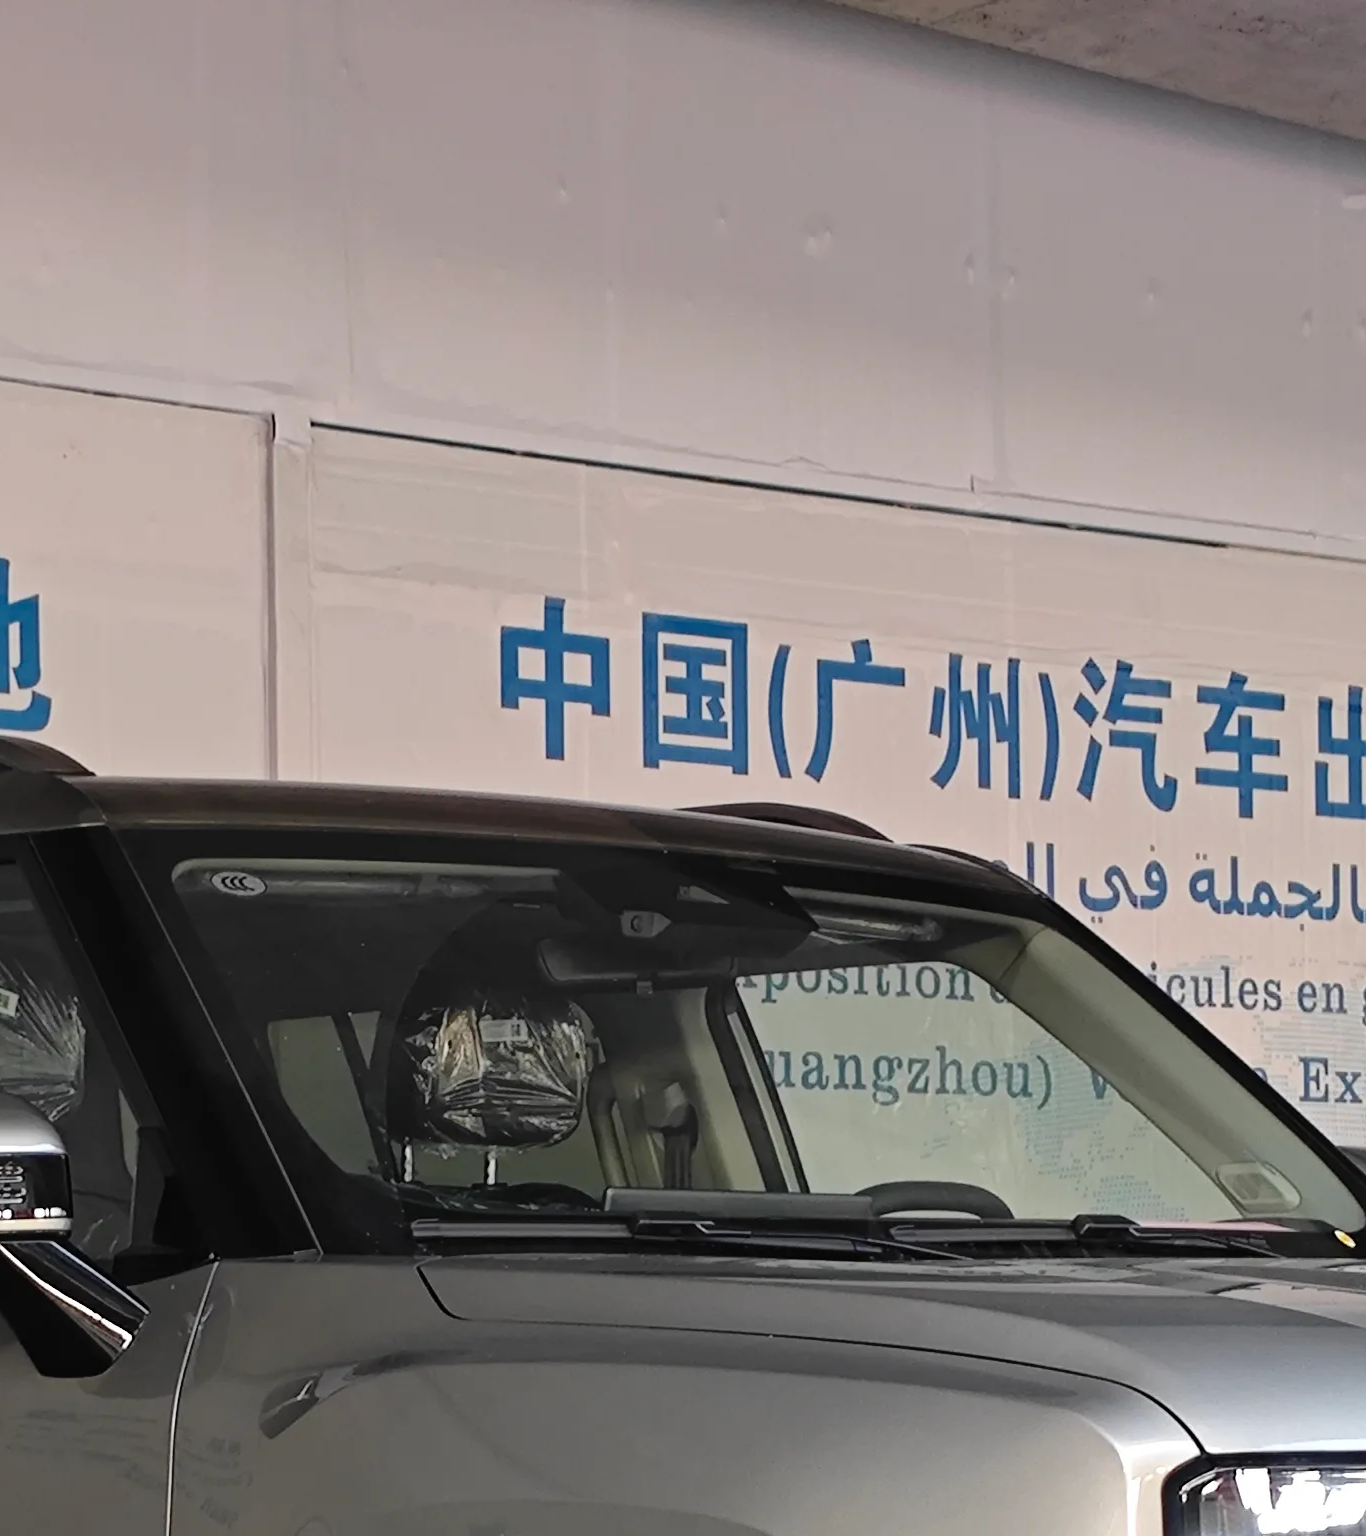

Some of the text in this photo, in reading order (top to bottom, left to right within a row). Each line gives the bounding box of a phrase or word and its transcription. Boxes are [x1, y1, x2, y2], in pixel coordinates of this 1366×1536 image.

[1078, 845, 1169, 925] في
[1297, 981, 1348, 1015] en
[764, 1045, 1053, 1110] uangzhou)
